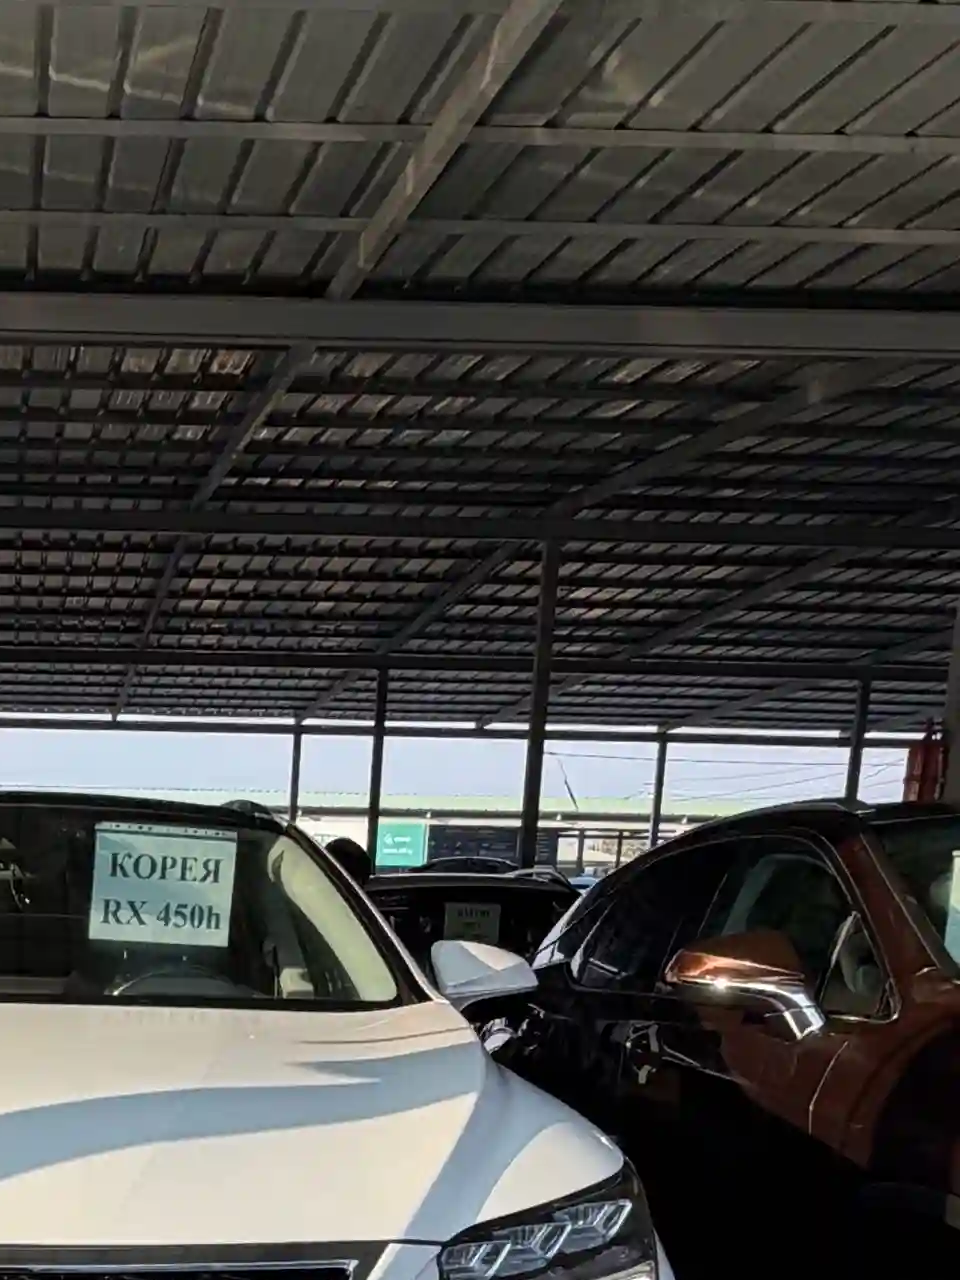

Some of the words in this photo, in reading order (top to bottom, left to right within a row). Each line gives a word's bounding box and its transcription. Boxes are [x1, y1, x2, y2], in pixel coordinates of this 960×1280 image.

[109, 852, 224, 883] КОРЕЯ
[101, 899, 147, 925] RX
[156, 902, 222, 930] 450h
